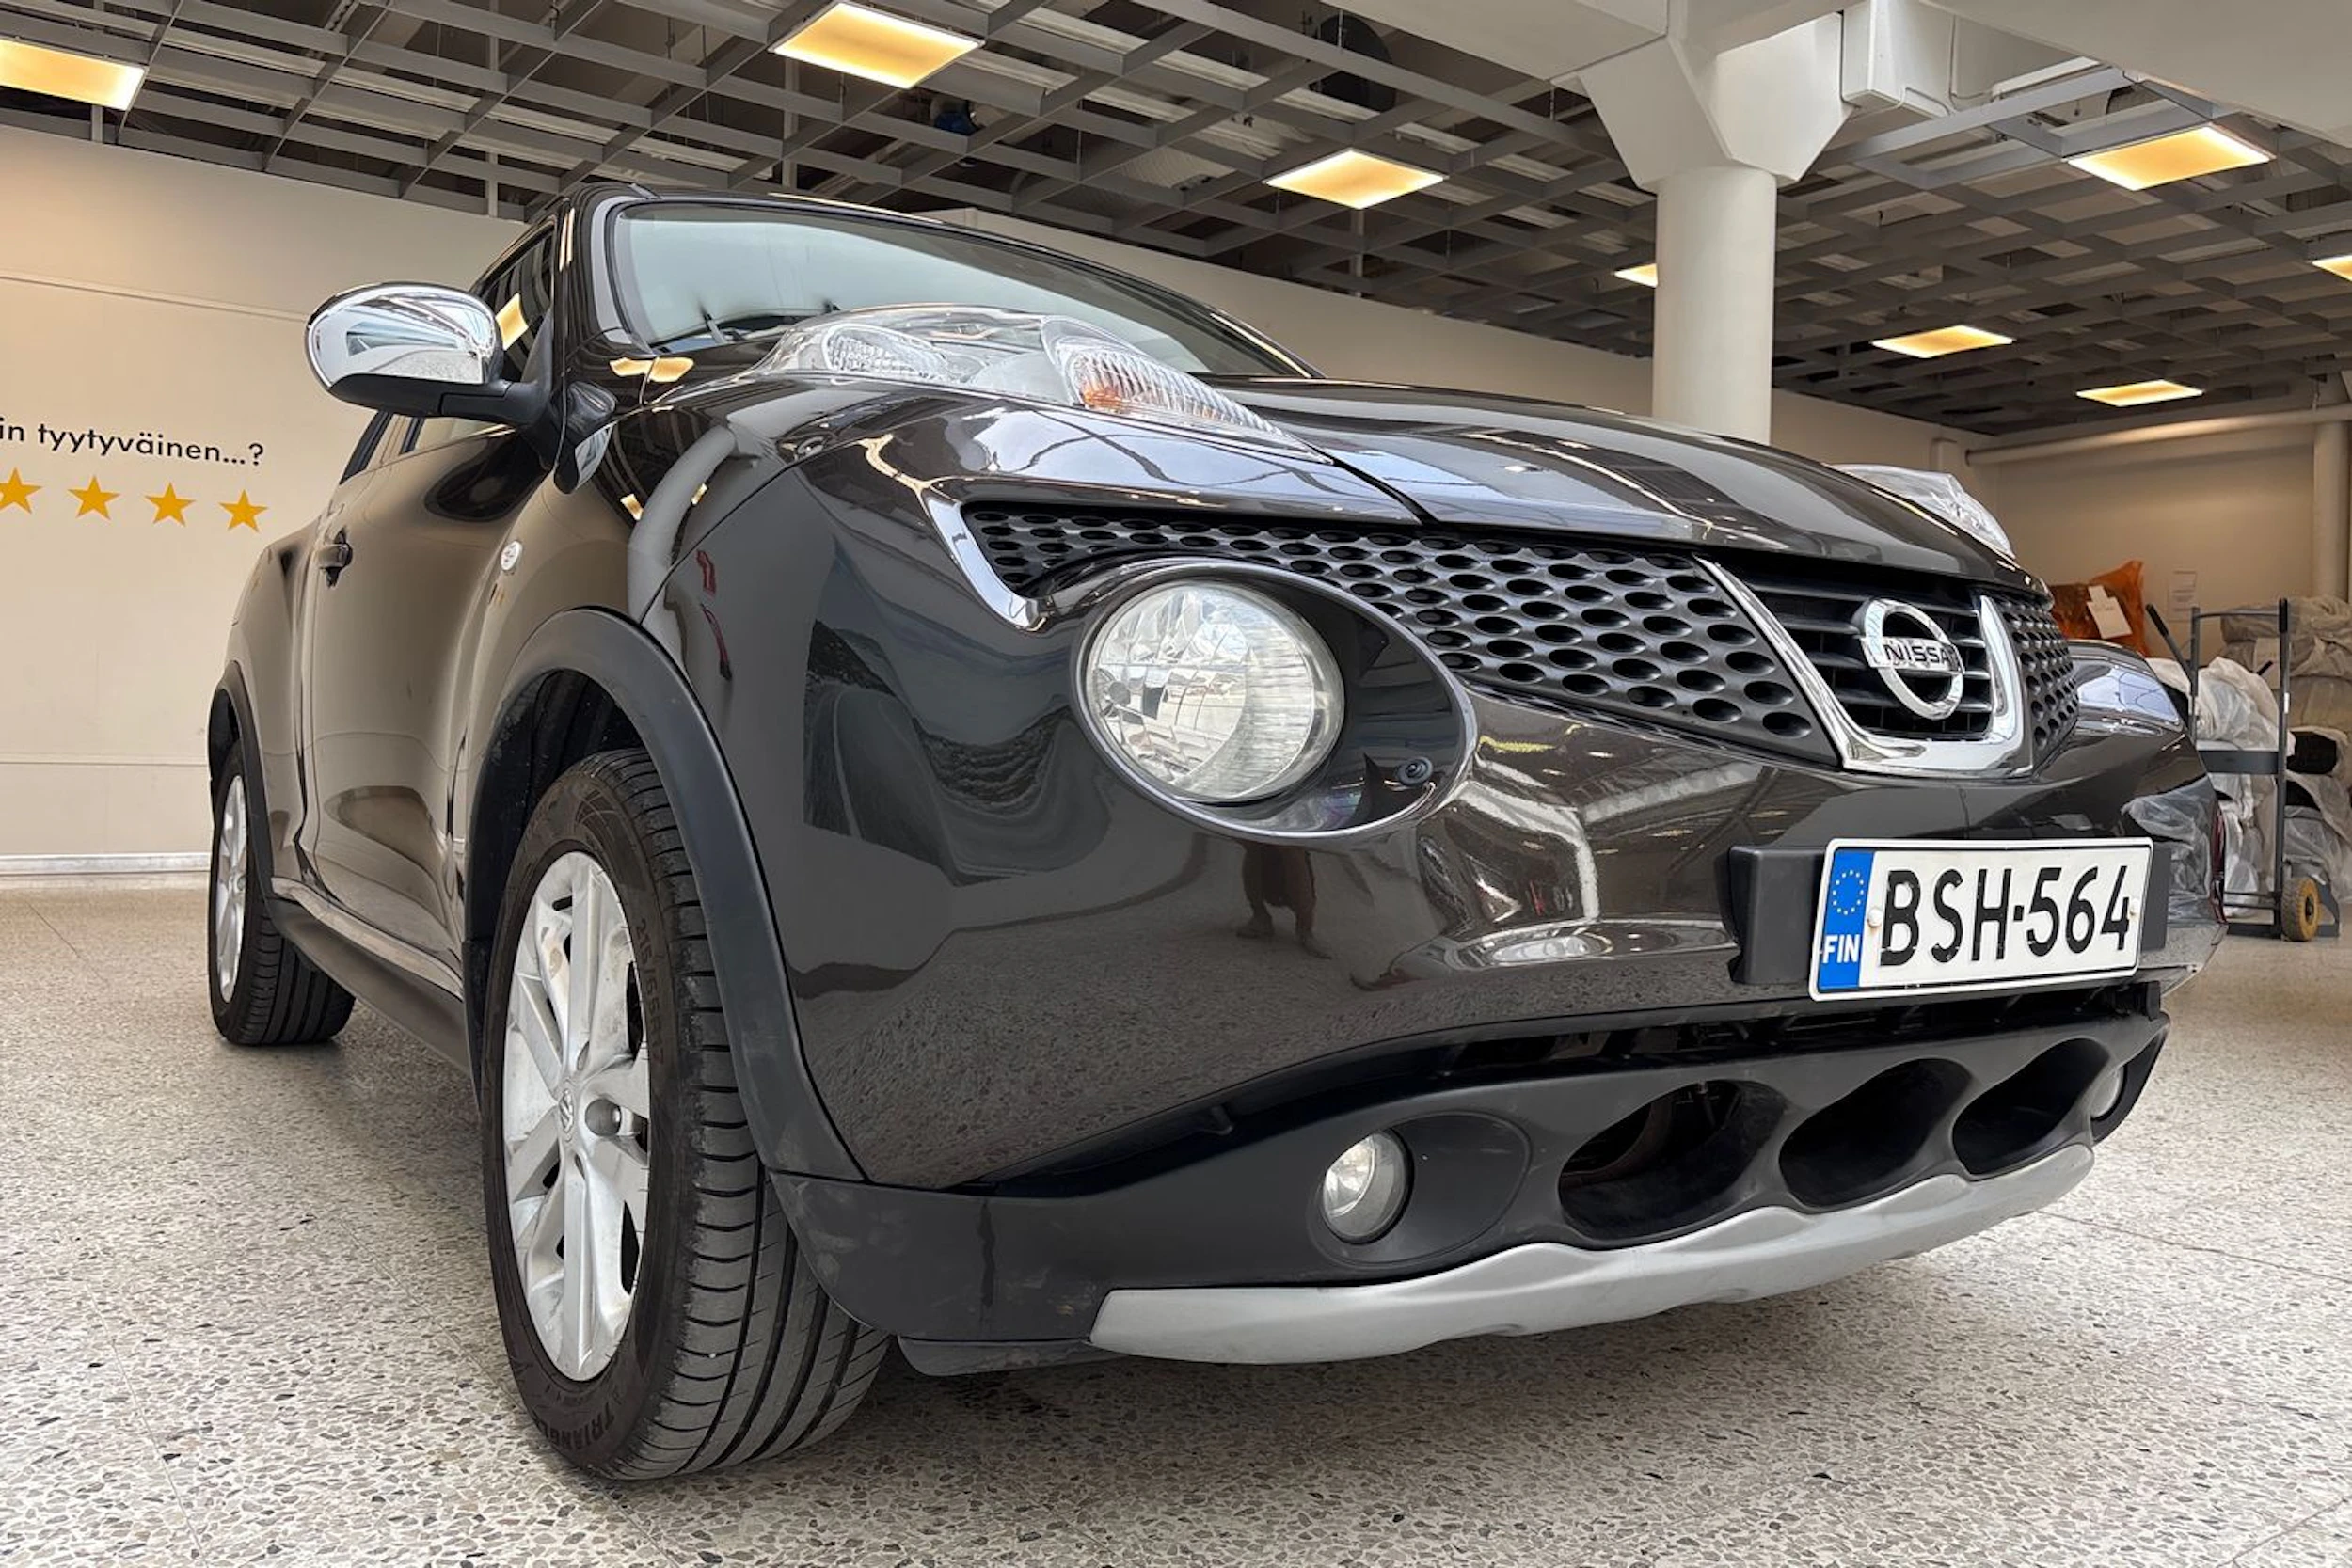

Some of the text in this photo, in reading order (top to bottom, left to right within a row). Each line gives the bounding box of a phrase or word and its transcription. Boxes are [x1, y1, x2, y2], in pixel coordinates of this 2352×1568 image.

[38, 423, 264, 466] tyytyväinen...?
[1883, 644, 1957, 668] NISSA
[1879, 865, 2130, 967] BSH-564
[1822, 934, 1861, 964] FIN
